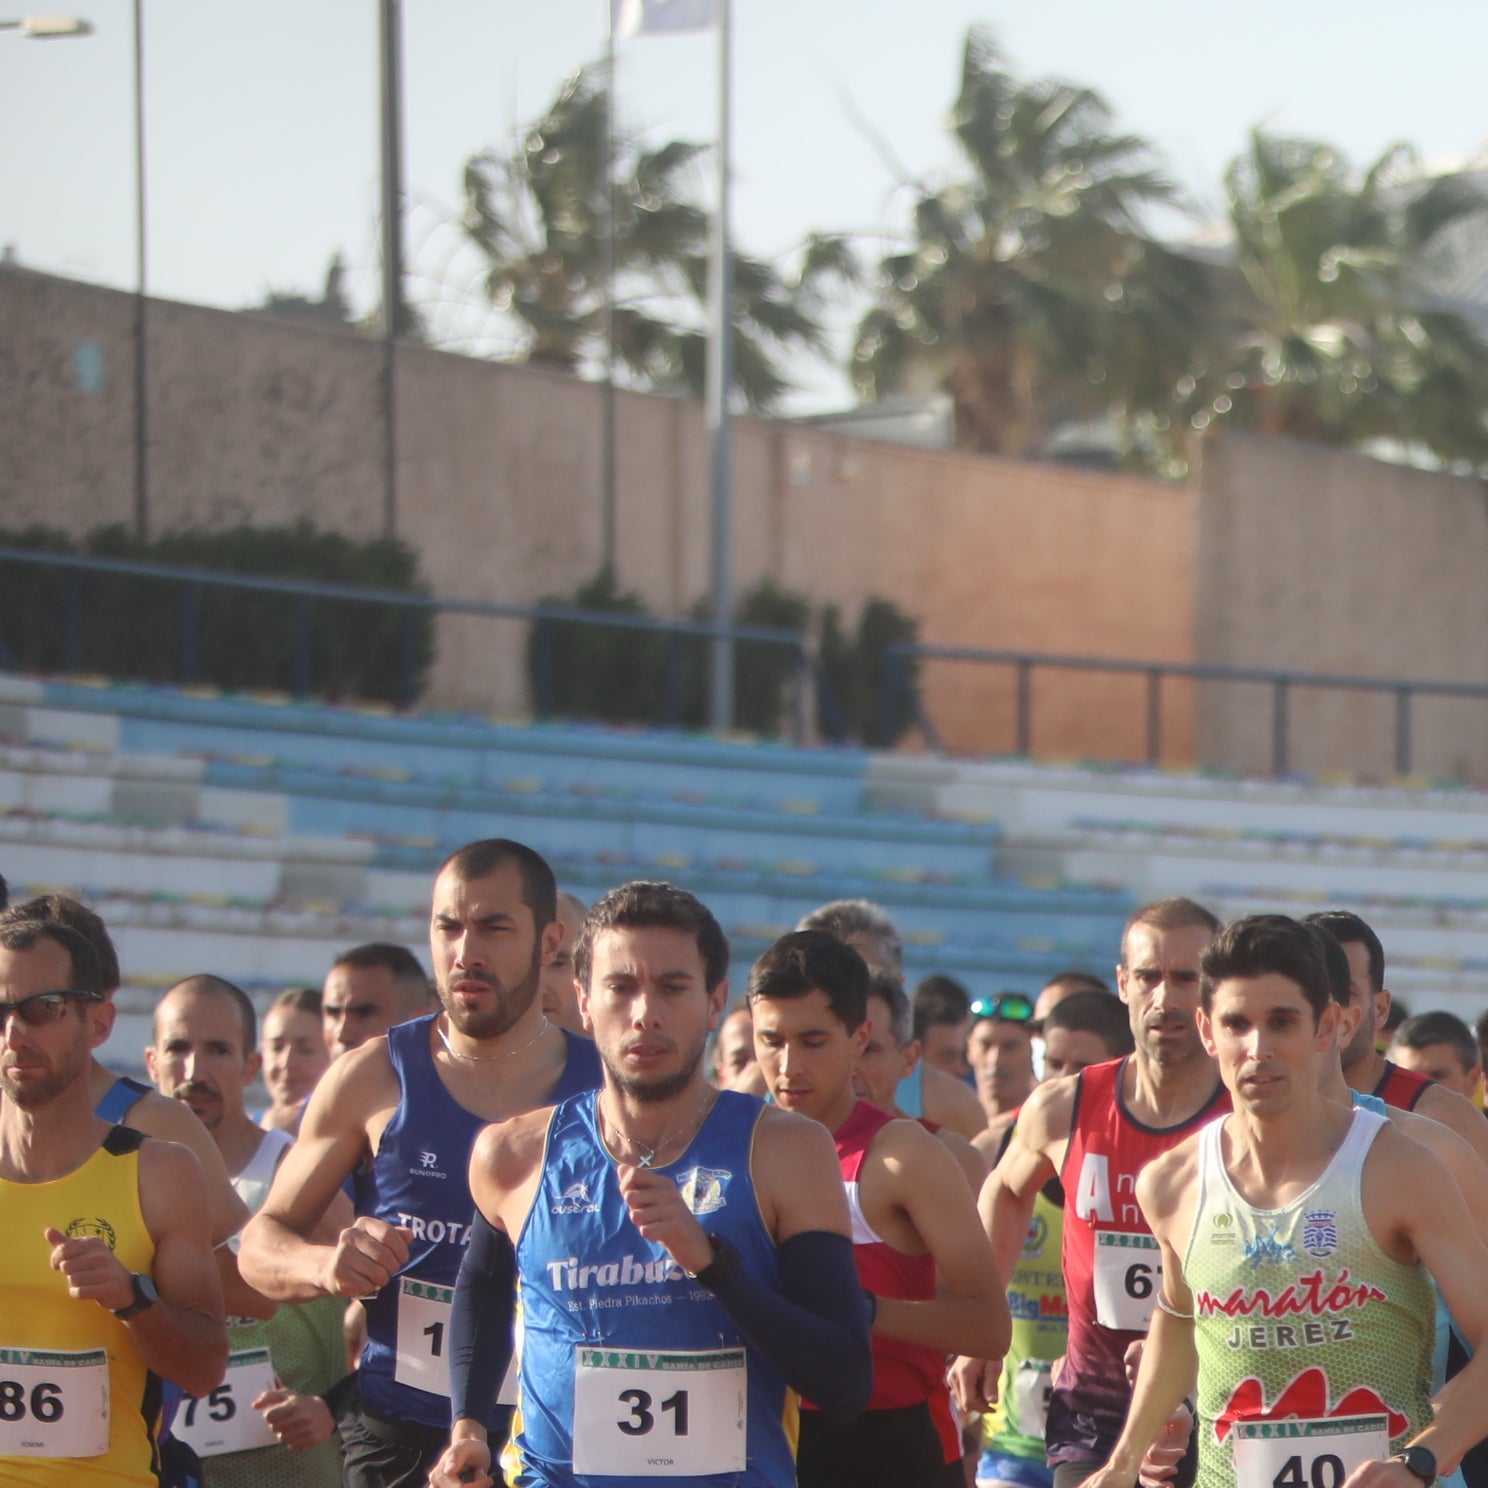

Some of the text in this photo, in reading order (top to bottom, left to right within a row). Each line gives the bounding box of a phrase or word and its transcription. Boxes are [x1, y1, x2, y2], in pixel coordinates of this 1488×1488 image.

[1125, 1263, 1163, 1299] 6
[1197, 1269, 1387, 1319] maratón
[1227, 1319, 1353, 1349] JEREZ
[583, 1351, 660, 1369] XXXIV
[0, 1380, 64, 1424] 86
[617, 1388, 689, 1437] 31
[1239, 1423, 1311, 1439] XXXIV
[647, 1458, 674, 1466] VICTOR
